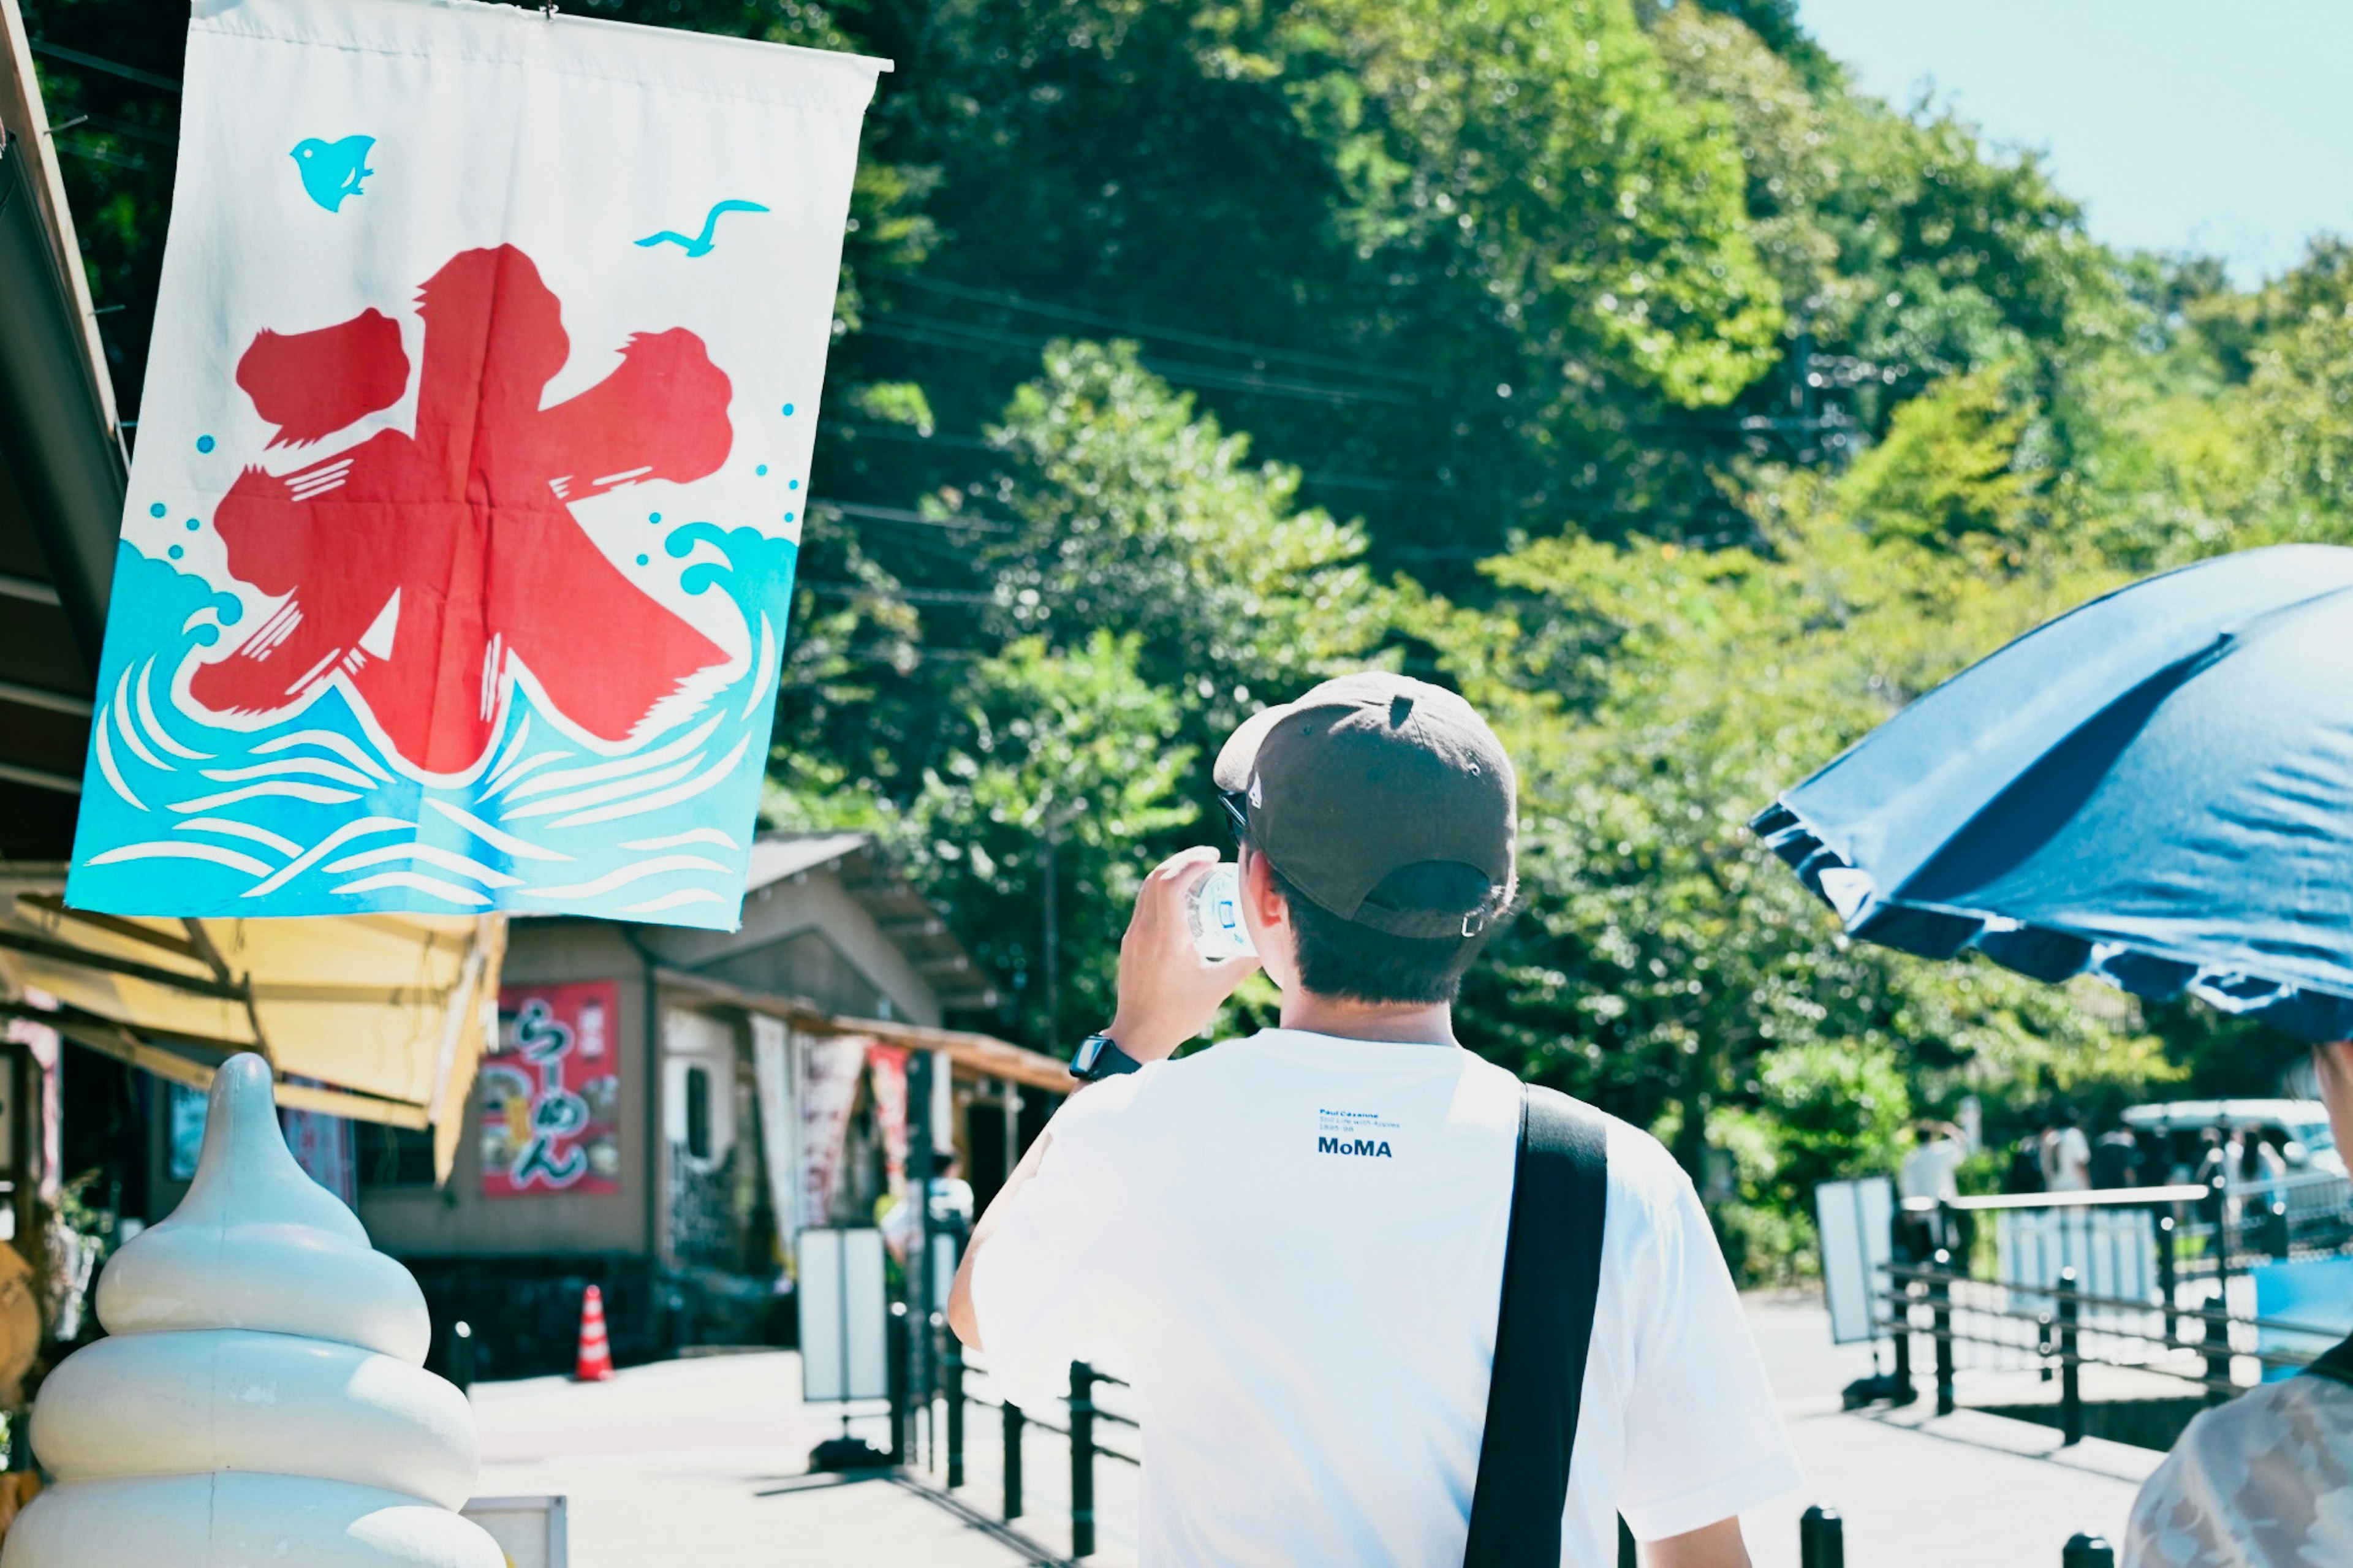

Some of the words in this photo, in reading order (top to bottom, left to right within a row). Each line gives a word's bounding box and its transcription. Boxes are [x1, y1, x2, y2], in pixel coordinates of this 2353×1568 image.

[189, 243, 735, 775] 氷
[512, 999, 588, 1189] らーめん
[1319, 1137, 1392, 1158] MoMA
